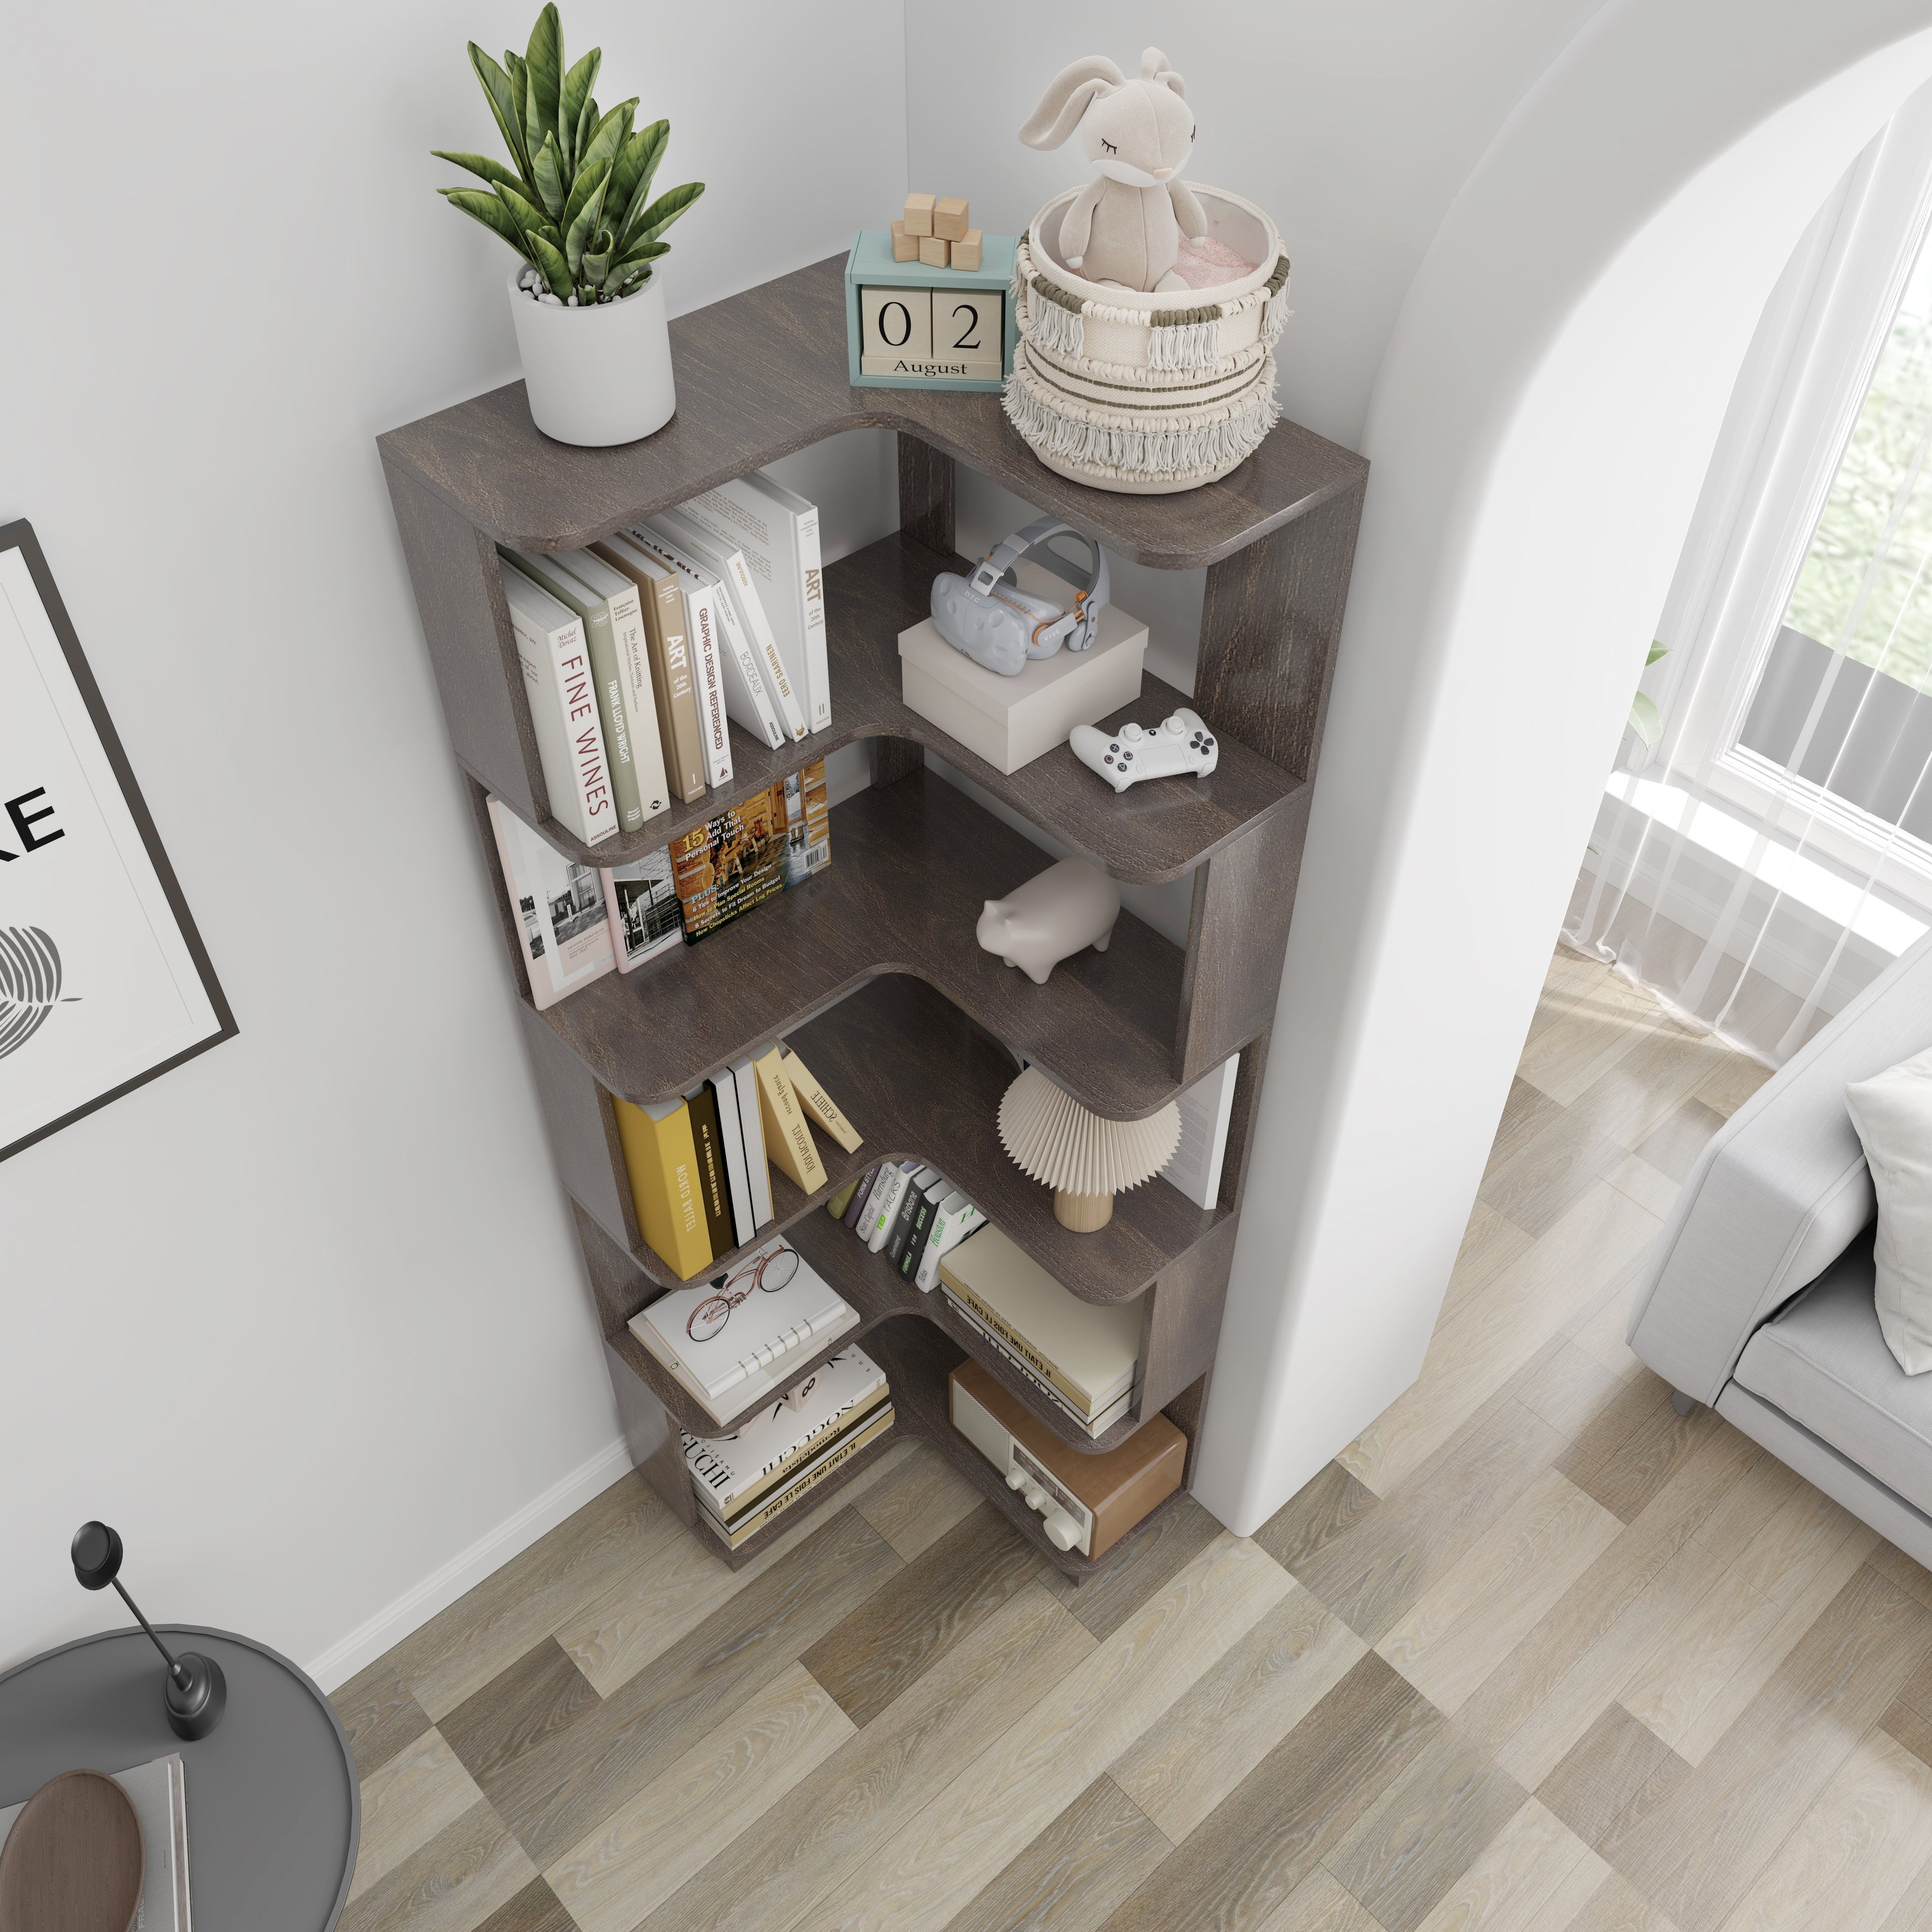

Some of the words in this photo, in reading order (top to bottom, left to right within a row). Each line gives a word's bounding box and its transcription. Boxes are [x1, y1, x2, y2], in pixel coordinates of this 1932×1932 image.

[894, 360, 968, 376] August
[736, 561, 748, 586] ASSOULINE
[805, 569, 821, 602] ART
[613, 599, 634, 611] Françoise
[614, 607, 630, 616] Tellier-
[615, 608, 637, 622] Loumagne
[699, 608, 712, 653] GRAPHIC
[808, 619, 824, 630] Century
[811, 614, 820, 622] 20th
[557, 627, 577, 643] Michel
[558, 636, 577, 648] Dovaz
[1043, 628, 1061, 641] VIVE
[523, 655, 537, 670] expert
[667, 635, 687, 670] ART
[765, 643, 783, 677] SAARINEN
[634, 660, 643, 689] Knitting
[705, 653, 716, 690] DESIGN
[740, 652, 763, 697] BORDEAUX
[561, 655, 592, 722] FINE
[608, 679, 620, 710] FRANK
[673, 687, 691, 698] Century
[676, 681, 687, 690] 20th
[779, 677, 790, 698] EERO
[612, 706, 624, 733] LLOYD
[709, 689, 723, 750] REFERENCED
[769, 721, 779, 742] ASSOULINE
[816, 716, 830, 725] TASCHEN
[615, 733, 630, 764] WRIGHT
[576, 726, 609, 816] WINES
[688, 785, 703, 795] TASCHEN
[627, 807, 639, 815] Bruce
[627, 809, 640, 819] Brooks
[0, 786, 65, 862] E
[590, 824, 617, 842] ASSOULINE
[682, 827, 704, 853] 15
[704, 816, 725, 831] Ways
[707, 826, 721, 841] Add
[723, 816, 741, 830] That
[685, 837, 719, 862] Personal
[721, 824, 744, 841] Touch
[691, 883, 720, 905] PLUS:
[693, 911, 706, 921] How
[714, 899, 726, 909] Plan
[727, 887, 746, 903] Special
[747, 876, 765, 891] Rooms
[698, 901, 709, 910] Tips
[717, 883, 740, 899] Improve
[740, 875, 753, 885] Your
[754, 864, 772, 878] Design
[696, 927, 708, 937] How
[709, 910, 738, 929] Chopsticks
[739, 900, 755, 913] Affect
[756, 893, 766, 903] Log
[766, 883, 783, 896] Prices
[700, 911, 721, 926] Secrets
[729, 901, 737, 910] Fit
[737, 891, 755, 905] Dream
[762, 875, 781, 890] Budget
[568, 940, 583, 950] DESIGN
[857, 1182, 867, 1198] FORM
[865, 1168, 875, 1183] STYL
[873, 1167, 894, 1200] Harrisburg
[876, 1214, 886, 1230] TED
[883, 1179, 901, 1212] TALKS
[859, 1222, 868, 1234] State
[864, 1204, 875, 1223] Capital
[890, 1234, 901, 1258] Queensland
[901, 1191, 918, 1222] Brisbane
[902, 1251, 912, 1274] FORMULA
[916, 1206, 927, 1231] SUCCESS
[930, 1218, 946, 1248] Houston
[782, 1426, 841, 1474] Remodelista
[828, 1449, 848, 1468] ÉTAIT
[849, 1442, 856, 1451] IL
[812, 1467, 827, 1479] UNE
[784, 1493, 793, 1504] LE
[794, 1481, 811, 1495] FOIS
[763, 1500, 783, 1519] CAFÉ
